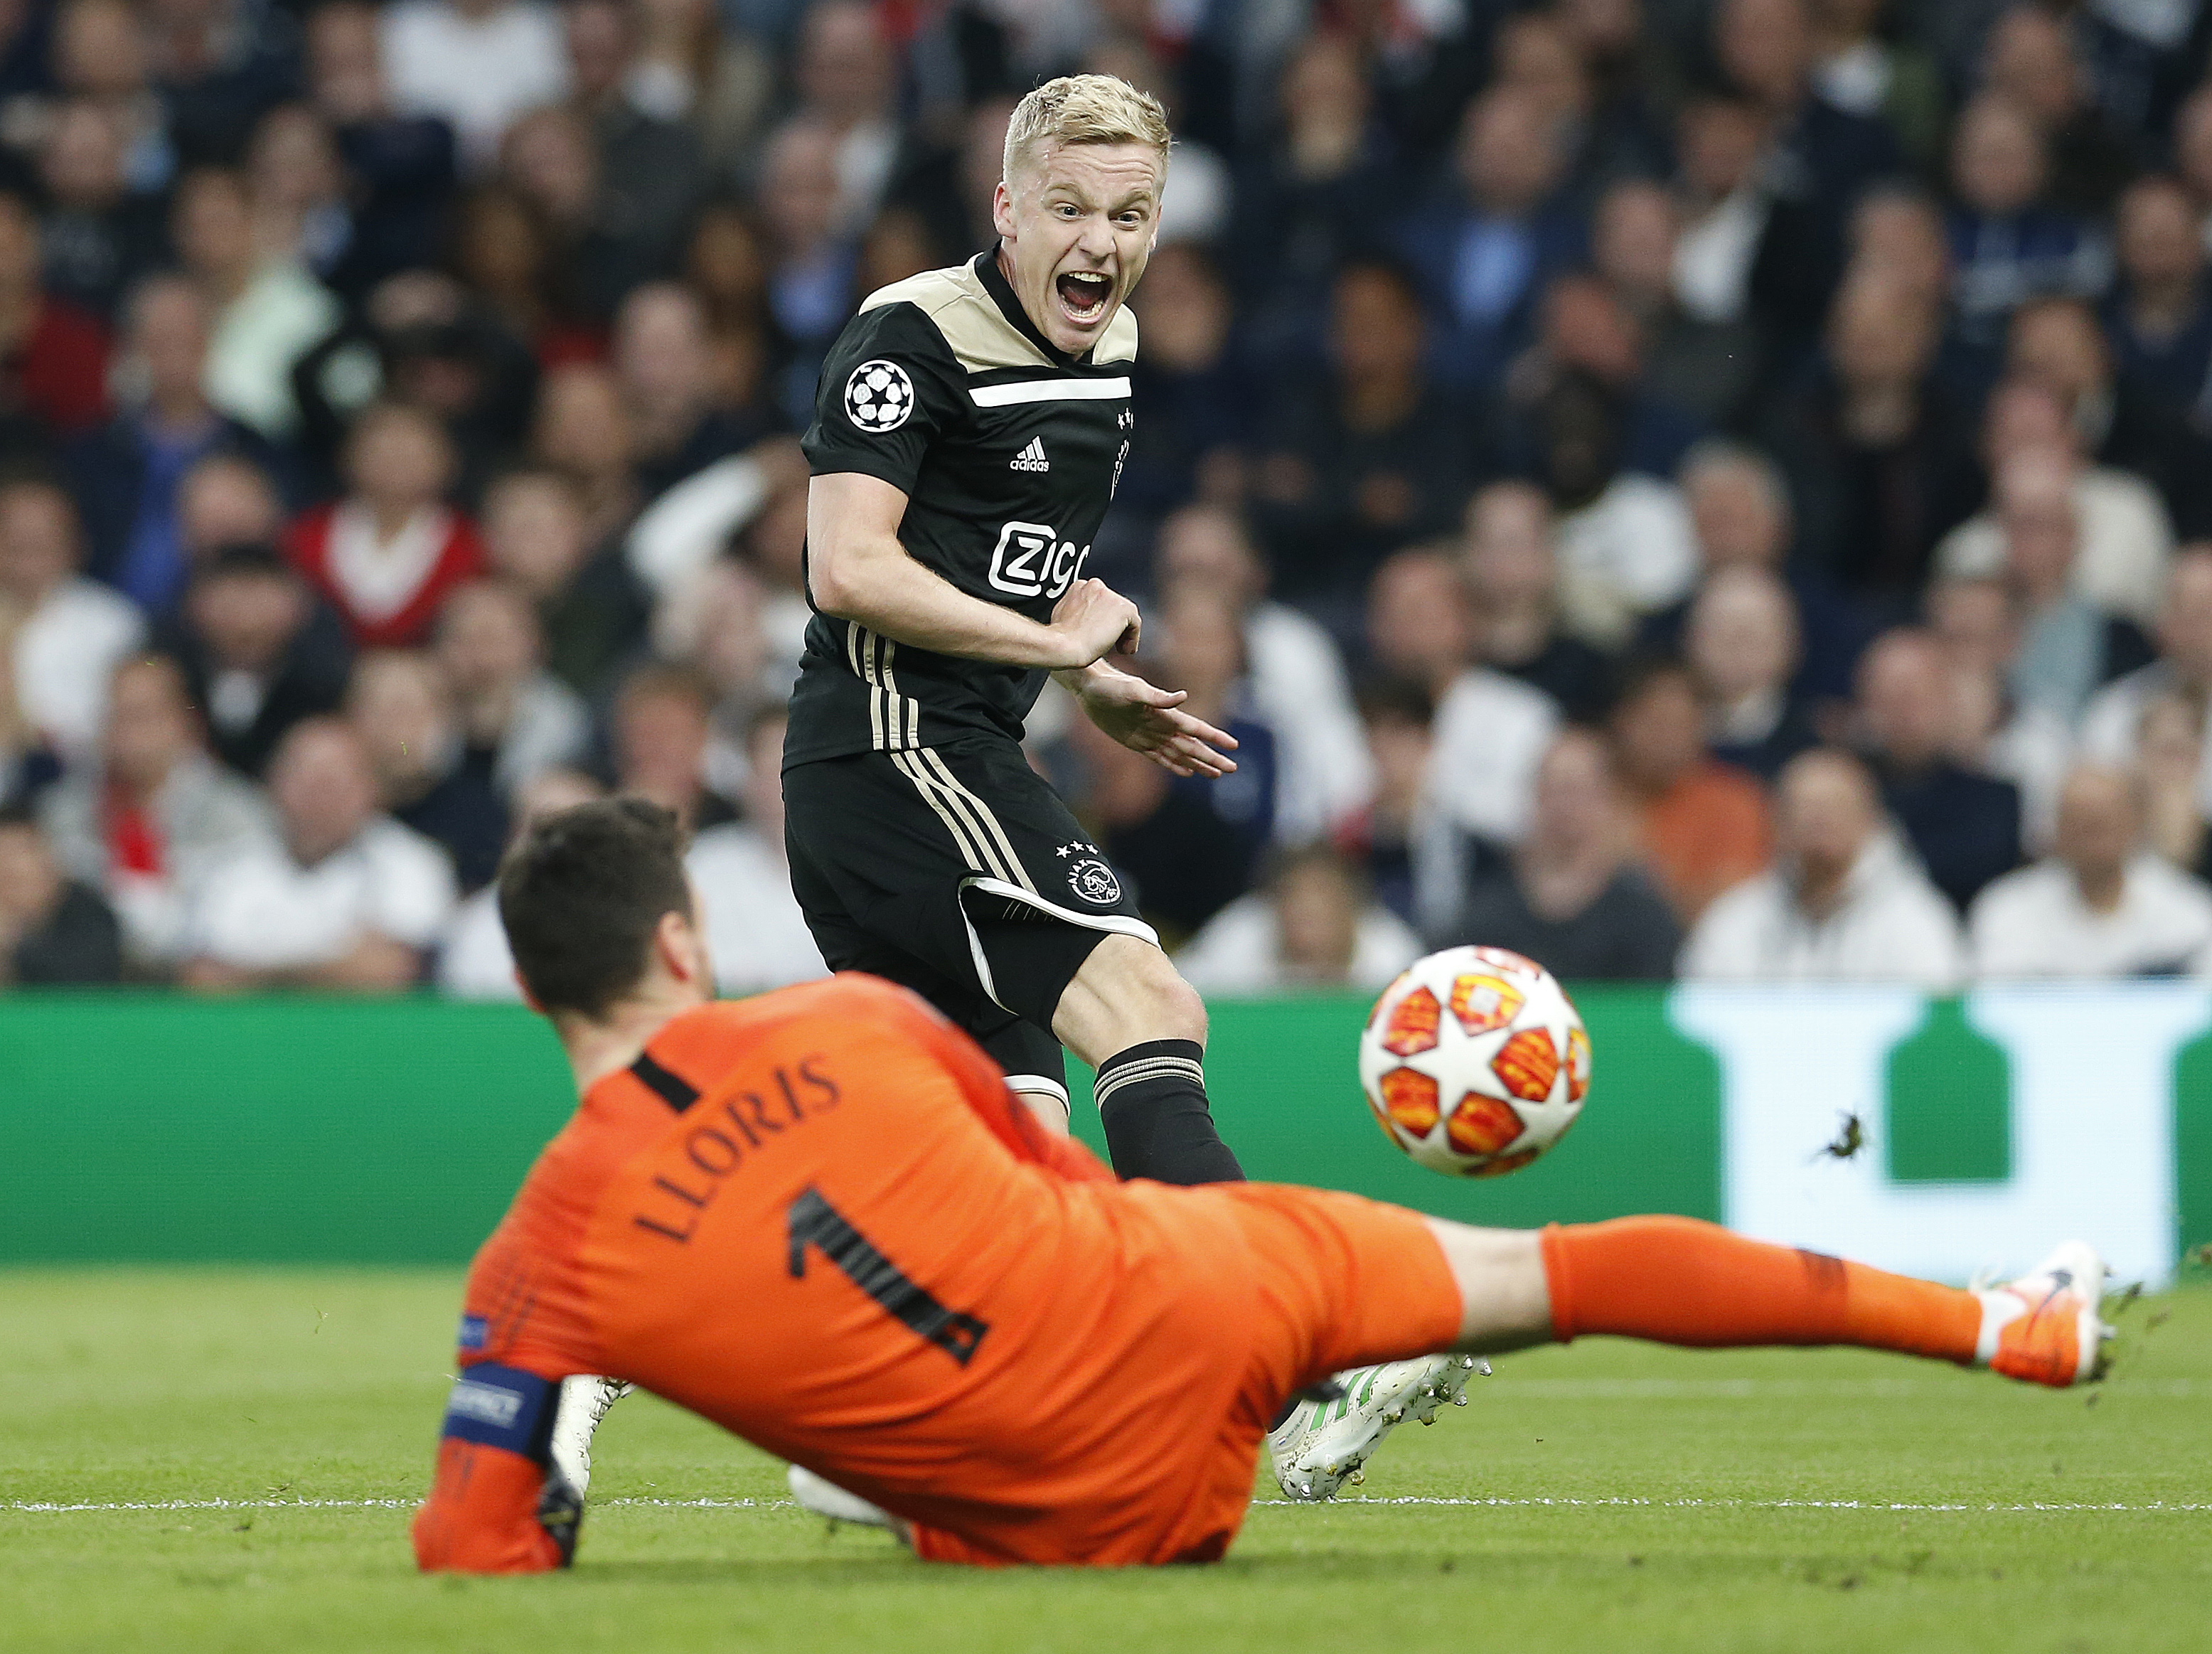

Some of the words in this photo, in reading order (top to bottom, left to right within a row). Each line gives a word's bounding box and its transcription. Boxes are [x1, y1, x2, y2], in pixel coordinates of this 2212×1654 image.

[1010, 459, 1049, 472] adidas
[1067, 859, 1089, 885] AJAX
[634, 1052, 841, 1244] LLORIS
[788, 1183, 991, 1370] 1
